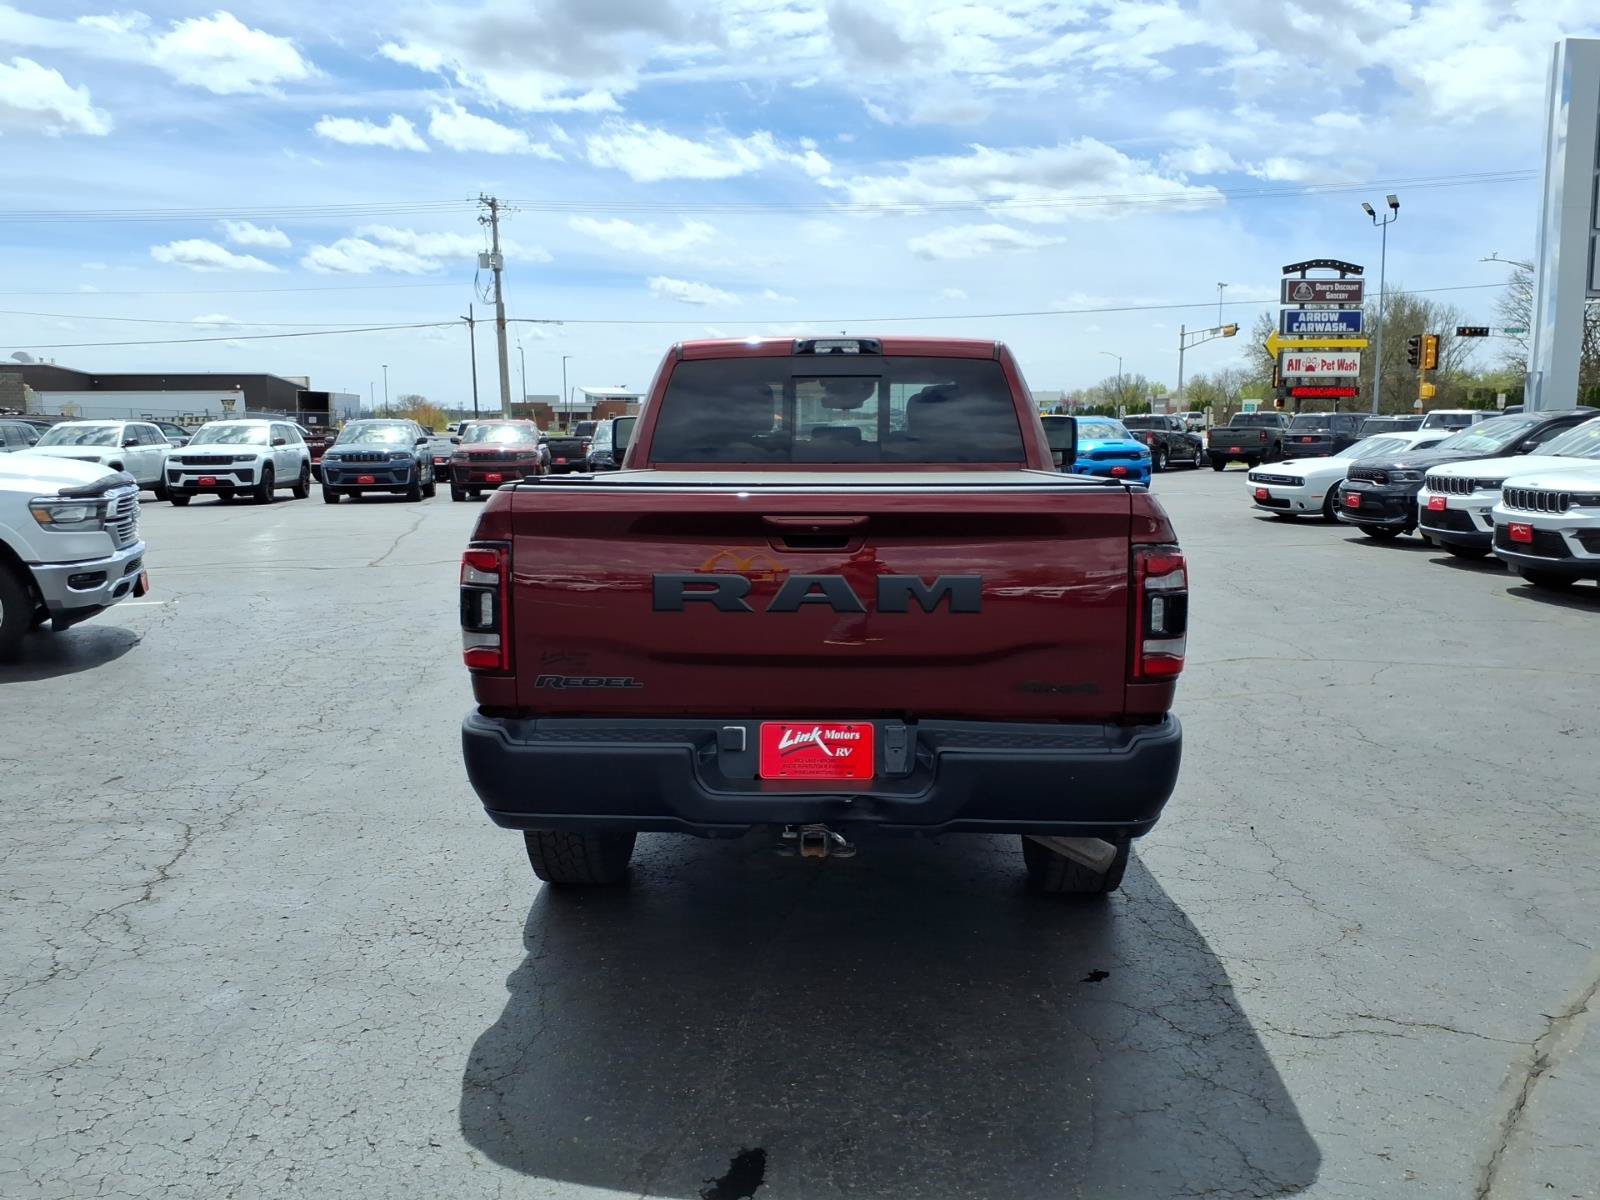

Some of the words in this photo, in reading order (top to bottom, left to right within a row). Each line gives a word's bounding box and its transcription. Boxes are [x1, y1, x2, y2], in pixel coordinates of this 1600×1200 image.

[1298, 312, 1339, 322] ARROW
[1287, 359, 1301, 371] All
[1320, 359, 1335, 371] Pet
[1337, 359, 1357, 371] Wash
[652, 574, 982, 613] RAM
[535, 674, 644, 689] REBEL
[778, 726, 834, 756] Link
[824, 729, 860, 740] Motors
[835, 747, 853, 757] RV
